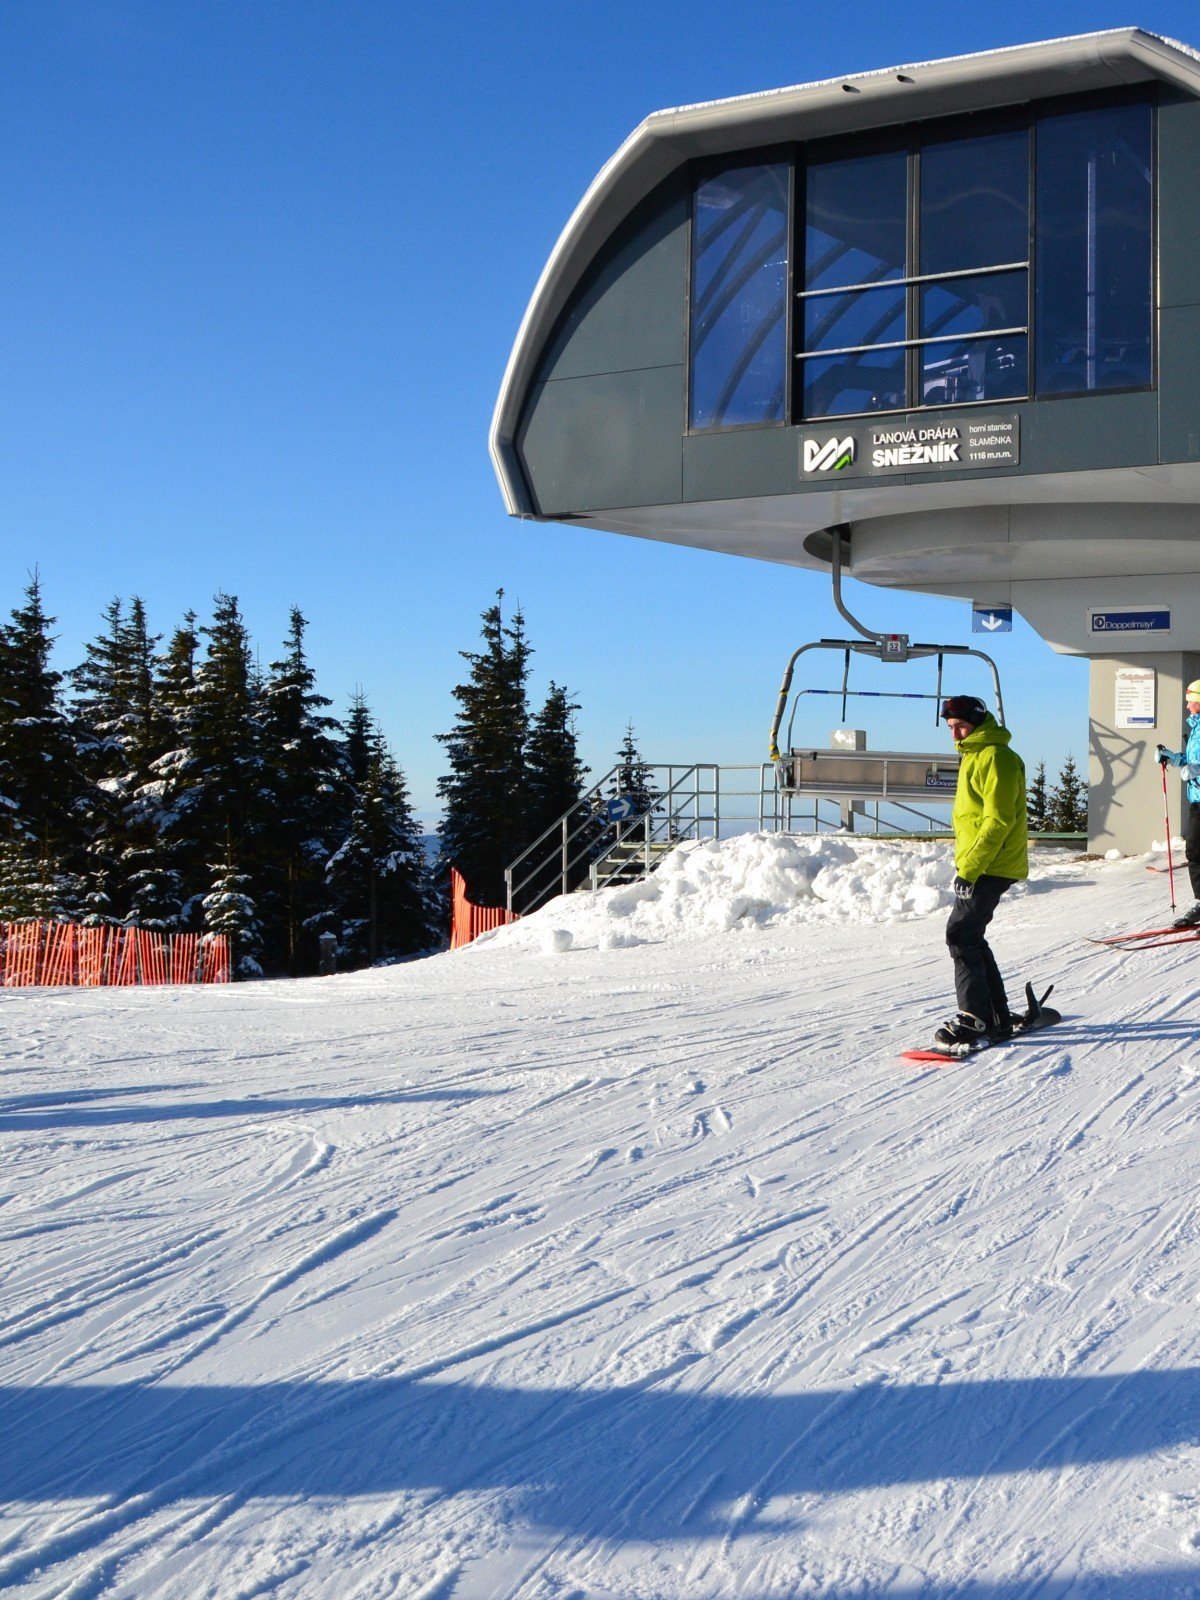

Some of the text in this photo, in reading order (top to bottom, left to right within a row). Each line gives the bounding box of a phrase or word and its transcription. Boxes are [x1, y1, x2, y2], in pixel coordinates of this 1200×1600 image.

[987, 422, 1012, 431] stanice
[873, 427, 959, 445] LANOVÁ DRÁHA
[872, 441, 960, 467] SNĚŽNÍK
[970, 452, 986, 460] 1116
[1105, 621, 1154, 630] Doppelmayr
